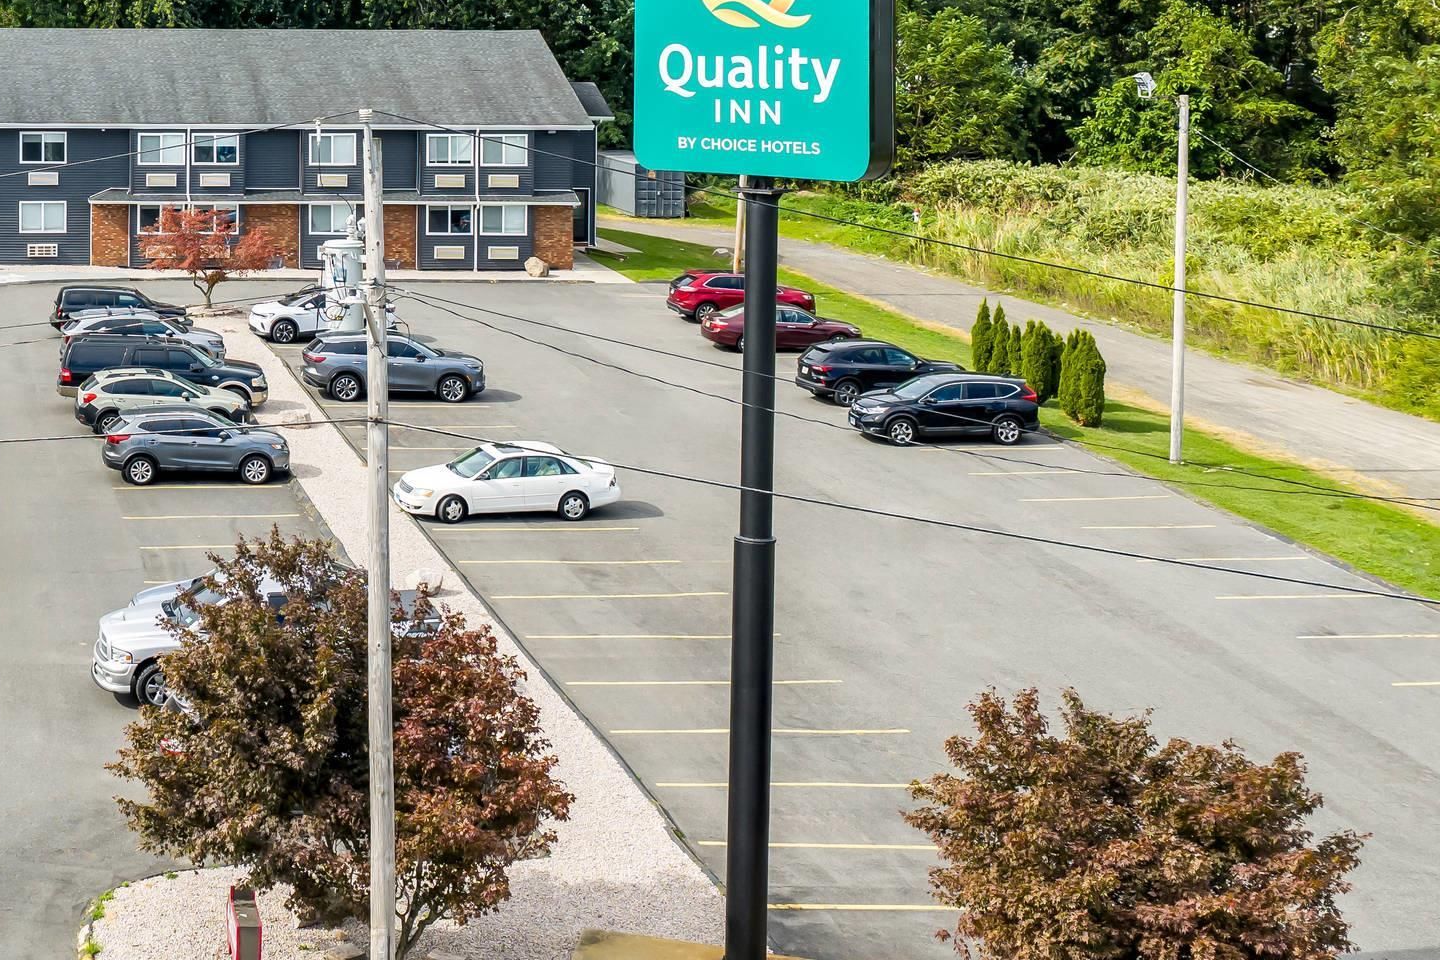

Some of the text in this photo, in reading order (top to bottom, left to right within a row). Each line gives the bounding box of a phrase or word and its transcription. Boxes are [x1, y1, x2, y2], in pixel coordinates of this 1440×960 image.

[658, 43, 841, 104] Quality
[714, 98, 781, 125] INN
[677, 136, 821, 155] BY CHOICE HOTELS
